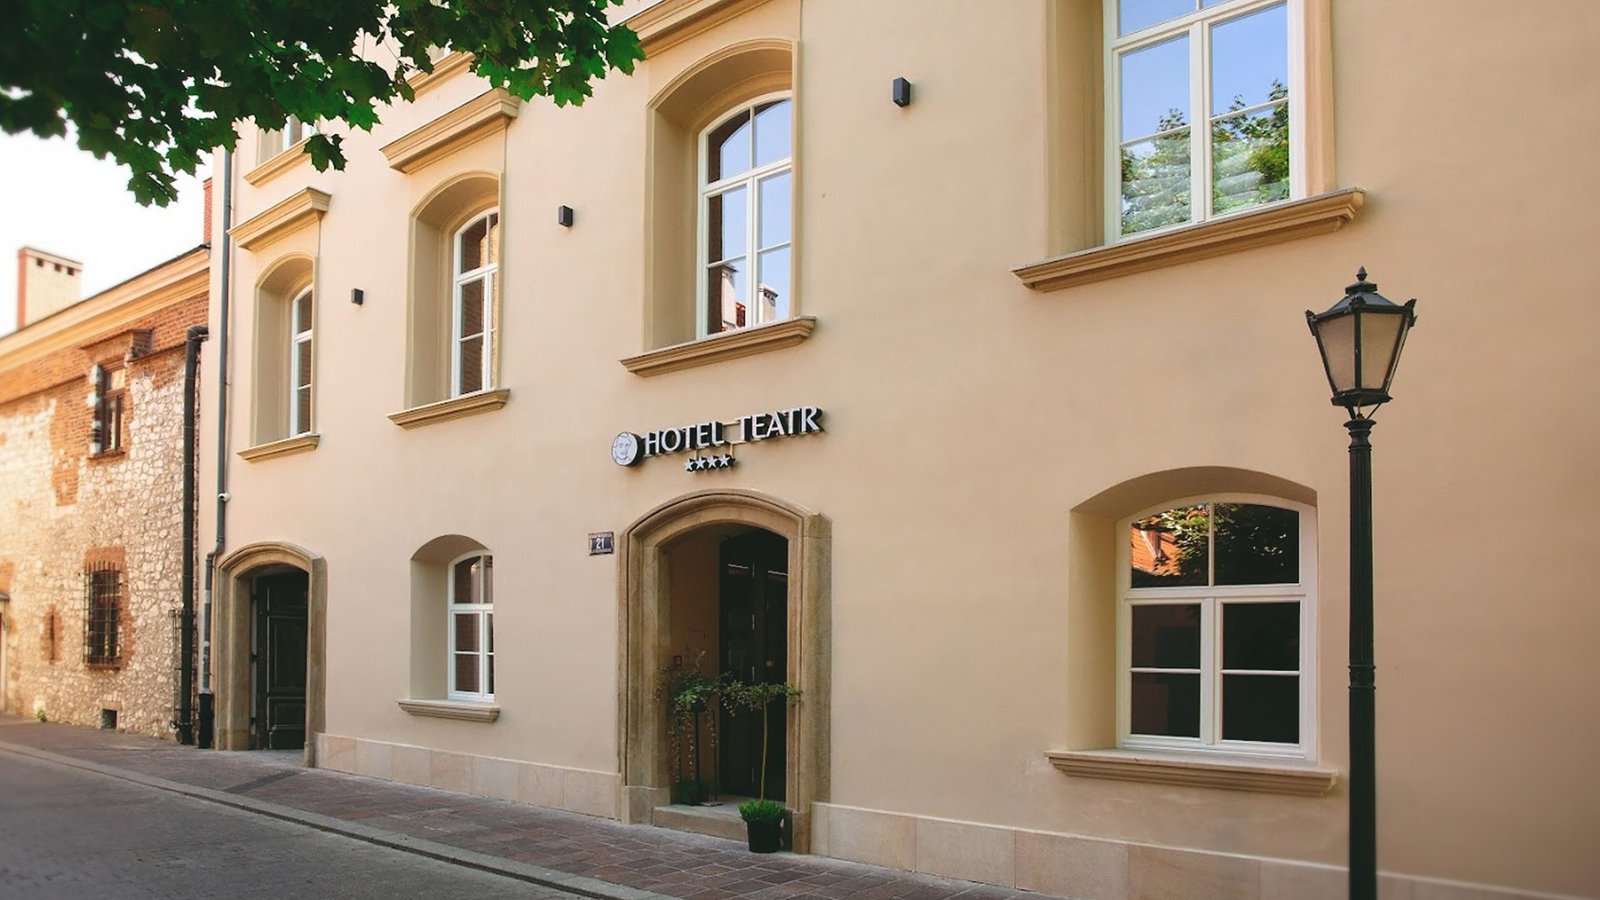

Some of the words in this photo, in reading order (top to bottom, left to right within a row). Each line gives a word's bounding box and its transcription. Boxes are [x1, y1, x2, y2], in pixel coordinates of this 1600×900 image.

[645, 421, 725, 455] HOTEL
[734, 406, 822, 442] TEATR
[595, 537, 605, 550] 21
